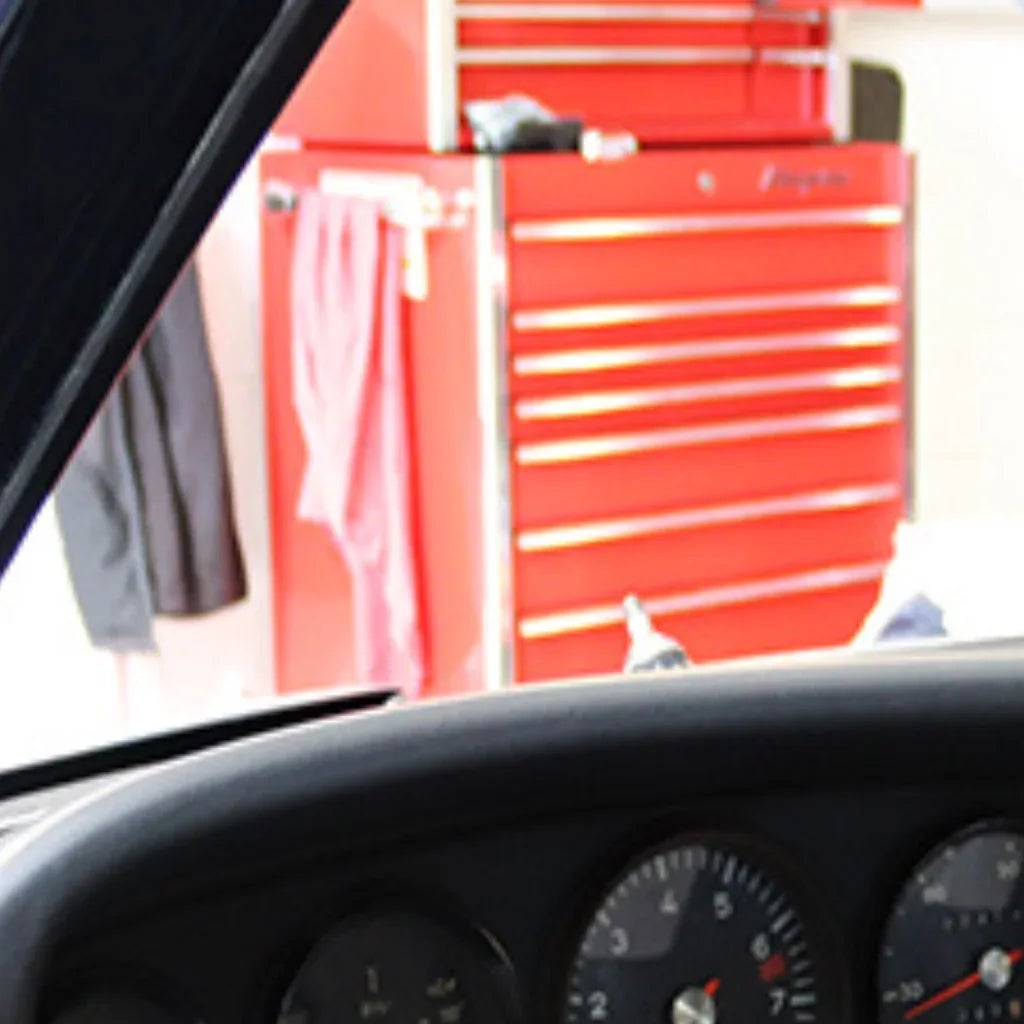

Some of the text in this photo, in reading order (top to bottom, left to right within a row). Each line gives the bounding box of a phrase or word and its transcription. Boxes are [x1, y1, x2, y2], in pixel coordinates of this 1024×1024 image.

[713, 890, 732, 920] 5
[610, 928, 630, 955] 3
[750, 934, 771, 960] 6
[586, 990, 608, 1020] 2
[769, 988, 788, 1015] 7
